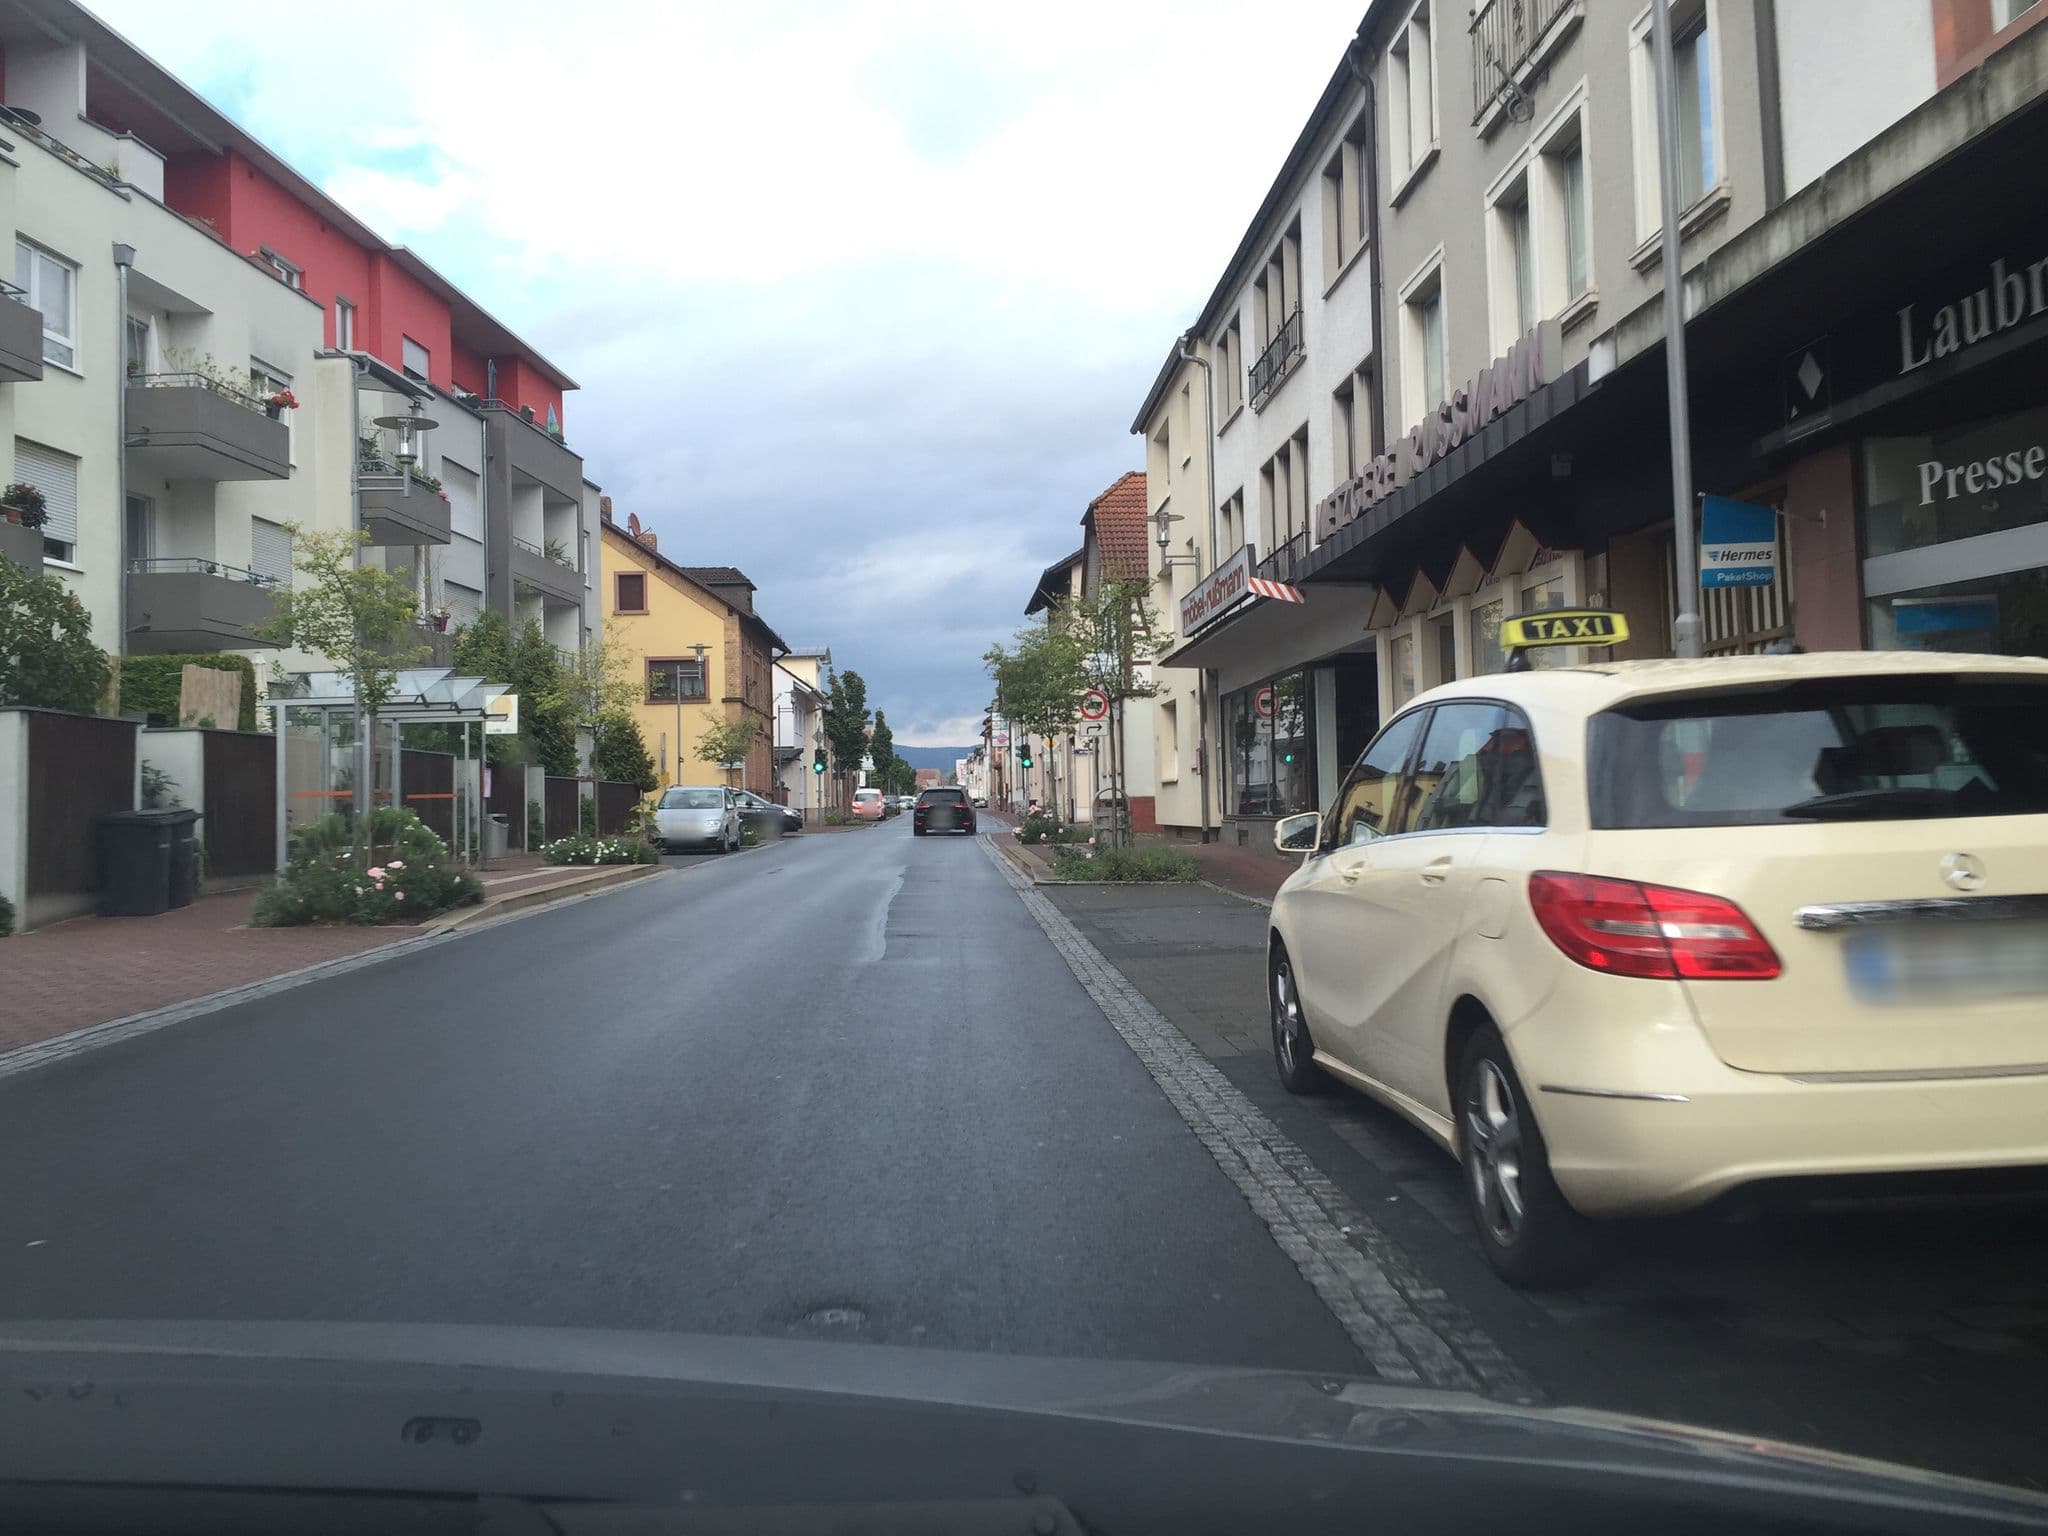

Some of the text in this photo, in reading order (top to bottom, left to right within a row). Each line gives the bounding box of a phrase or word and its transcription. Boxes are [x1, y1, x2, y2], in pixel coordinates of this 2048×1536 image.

[1916, 445, 2046, 507] Presse
[1720, 550, 1773, 562] Hermes
[1717, 571, 1773, 583] PaketShop
[1531, 617, 1606, 639] TAXI
